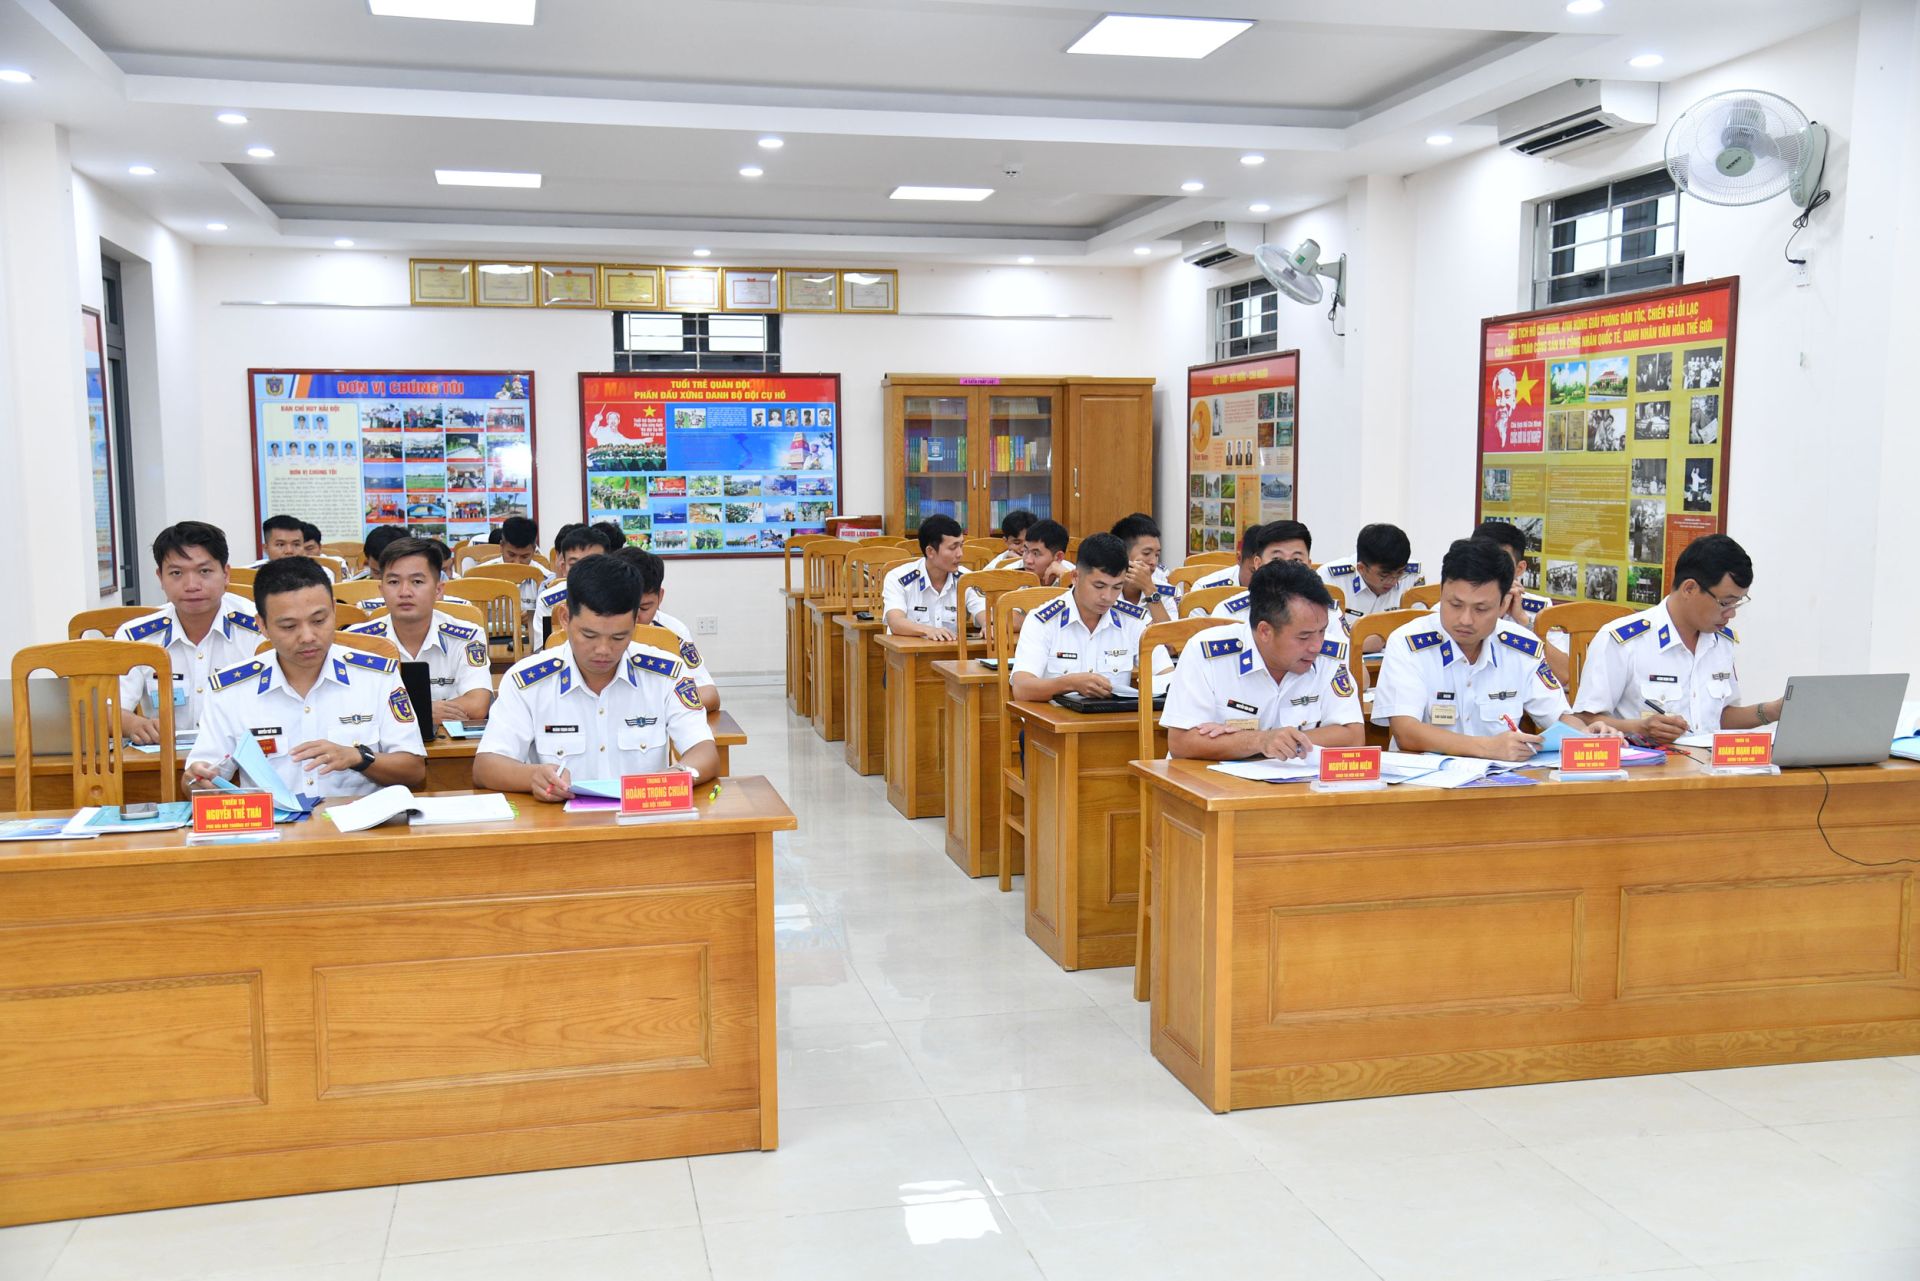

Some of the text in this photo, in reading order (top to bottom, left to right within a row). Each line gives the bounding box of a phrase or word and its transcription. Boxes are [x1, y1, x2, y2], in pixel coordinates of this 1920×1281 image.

[337, 379, 464, 397] ĐƠN VỊ CHÚNG TÔI
[671, 379, 690, 389] TUỔI
[692, 379, 707, 389] TRẺ
[710, 379, 733, 389] QUÂN
[735, 379, 750, 390] ĐỘI
[634, 389, 658, 399] PHẤN
[660, 389, 678, 399] ĐẤU
[680, 389, 704, 399] XỨNG
[705, 391, 729, 399] DANH
[731, 389, 743, 401] BỘ
[744, 389, 759, 401] ĐỘI
[761, 391, 773, 401] CỤ
[625, 785, 646, 800] HOÀNG
[647, 786, 667, 800] TRỌNG
[206, 805, 262, 820] NGUYỄN THẾ THÁI
